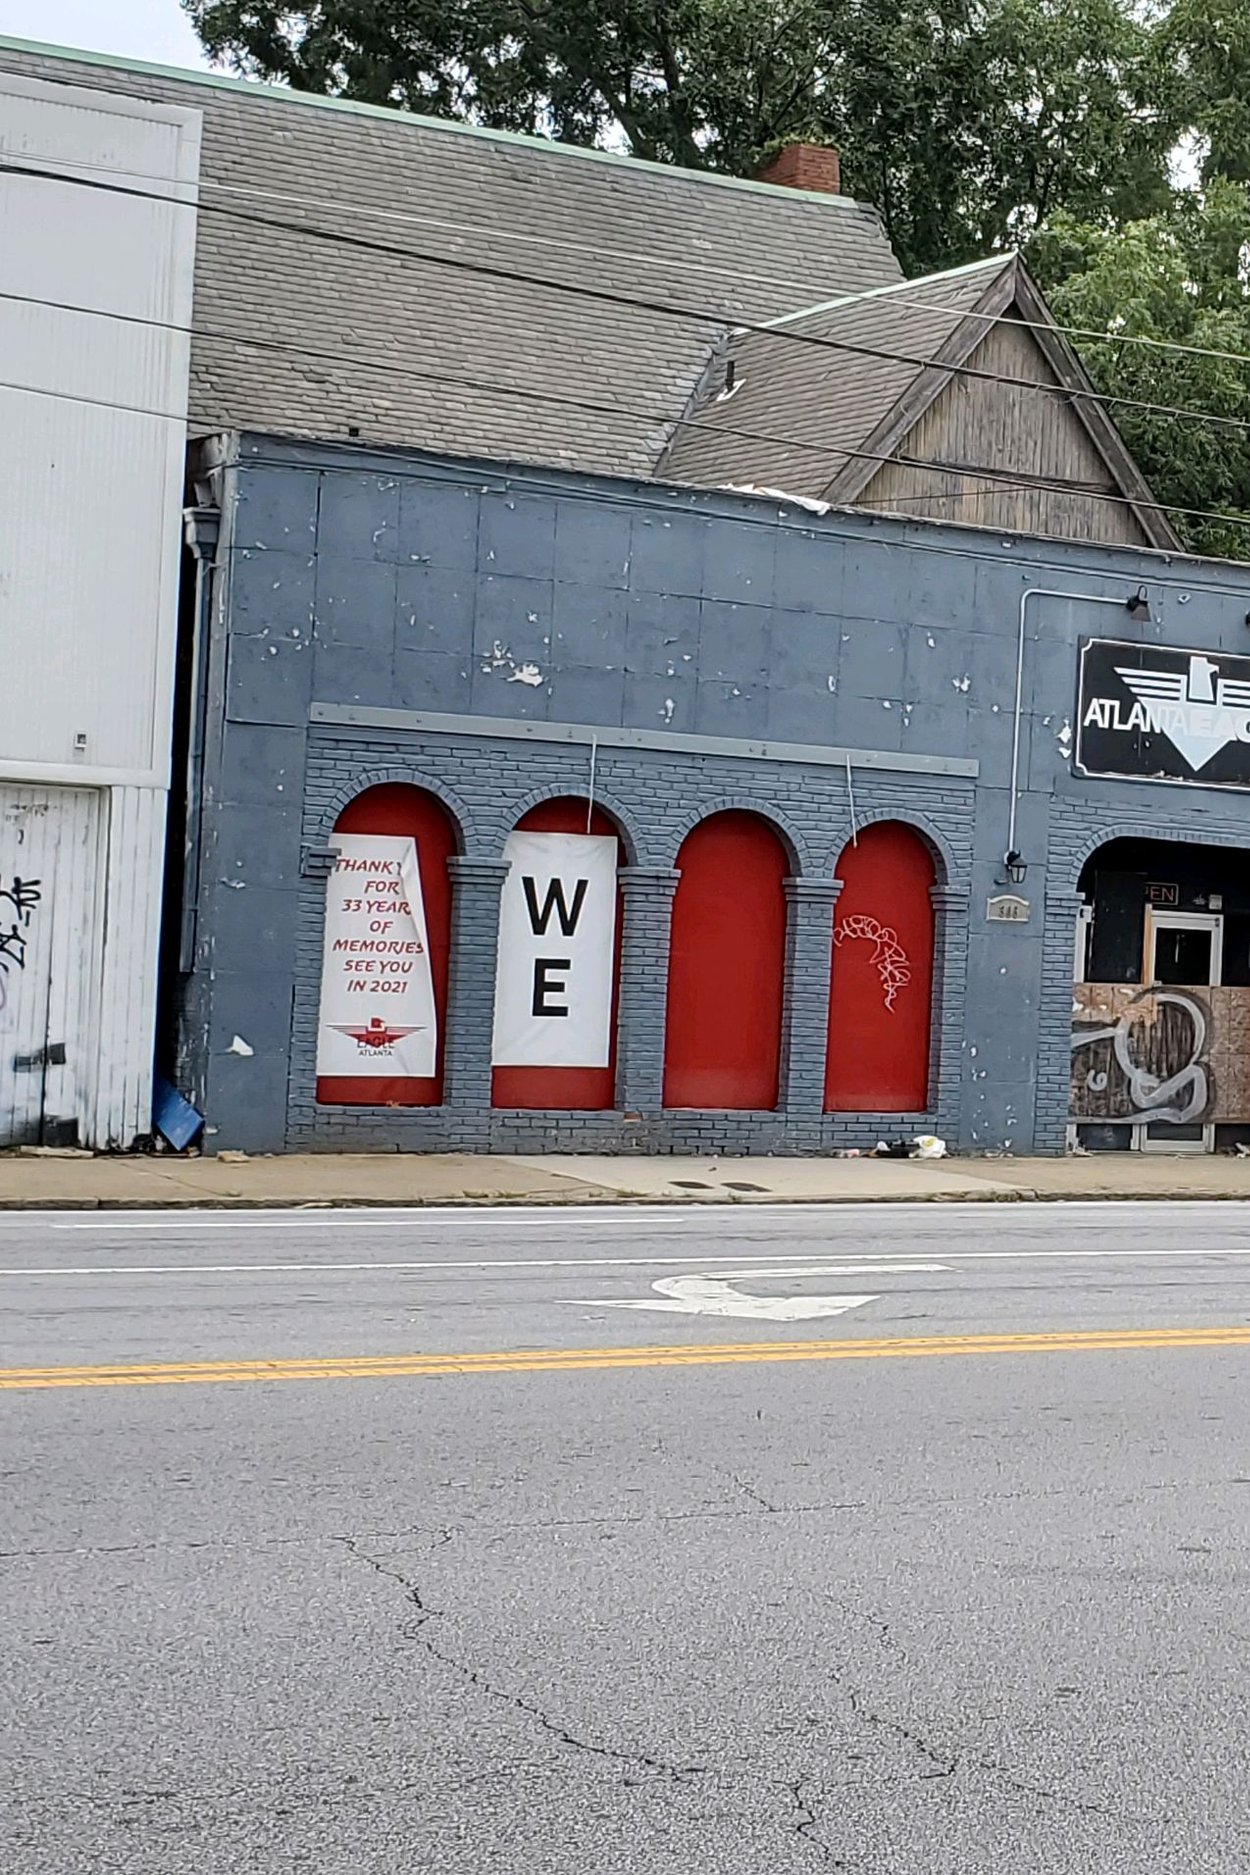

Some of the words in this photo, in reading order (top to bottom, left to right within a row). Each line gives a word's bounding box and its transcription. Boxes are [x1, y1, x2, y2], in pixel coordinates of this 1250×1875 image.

[1083, 697, 1188, 737] ATLANTA
[335, 859, 394, 875] THANK
[364, 881, 400, 895] FOR
[341, 899, 362, 912] 33
[369, 920, 393, 934] OF
[332, 939, 424, 955] MEMORIES
[521, 876, 590, 1017] WE
[343, 960, 376, 972] SEE
[379, 960, 413, 975] YOU
[346, 979, 367, 992] IN
[369, 980, 408, 993] 2021
[359, 1049, 393, 1057] ATLANTA
